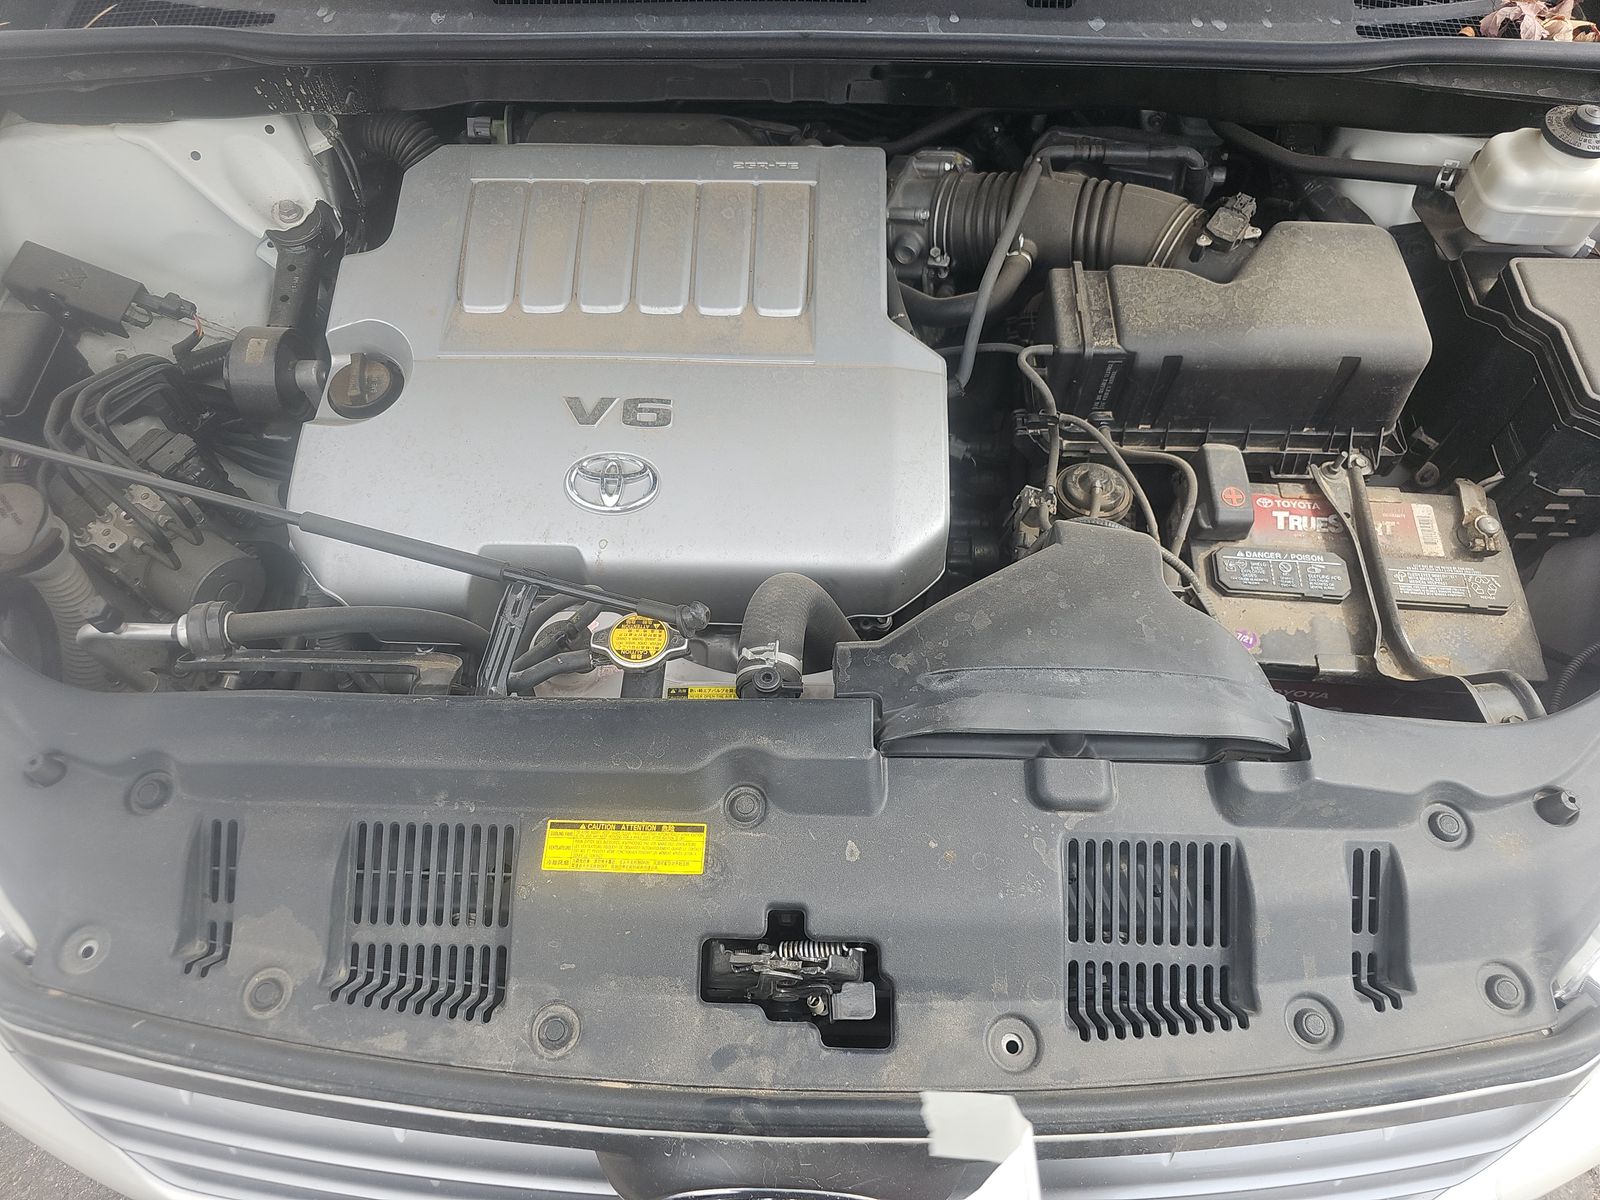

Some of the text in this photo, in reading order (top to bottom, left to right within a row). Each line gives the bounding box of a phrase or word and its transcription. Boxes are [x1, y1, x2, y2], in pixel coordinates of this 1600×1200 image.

[563, 396, 673, 428] V6
[1274, 499, 1321, 511] TOYOTA
[1244, 550, 1282, 560] DANGER
[1290, 553, 1325, 562] POISON
[587, 823, 616, 831] CAUTION
[620, 824, 657, 832] ATTENTION
